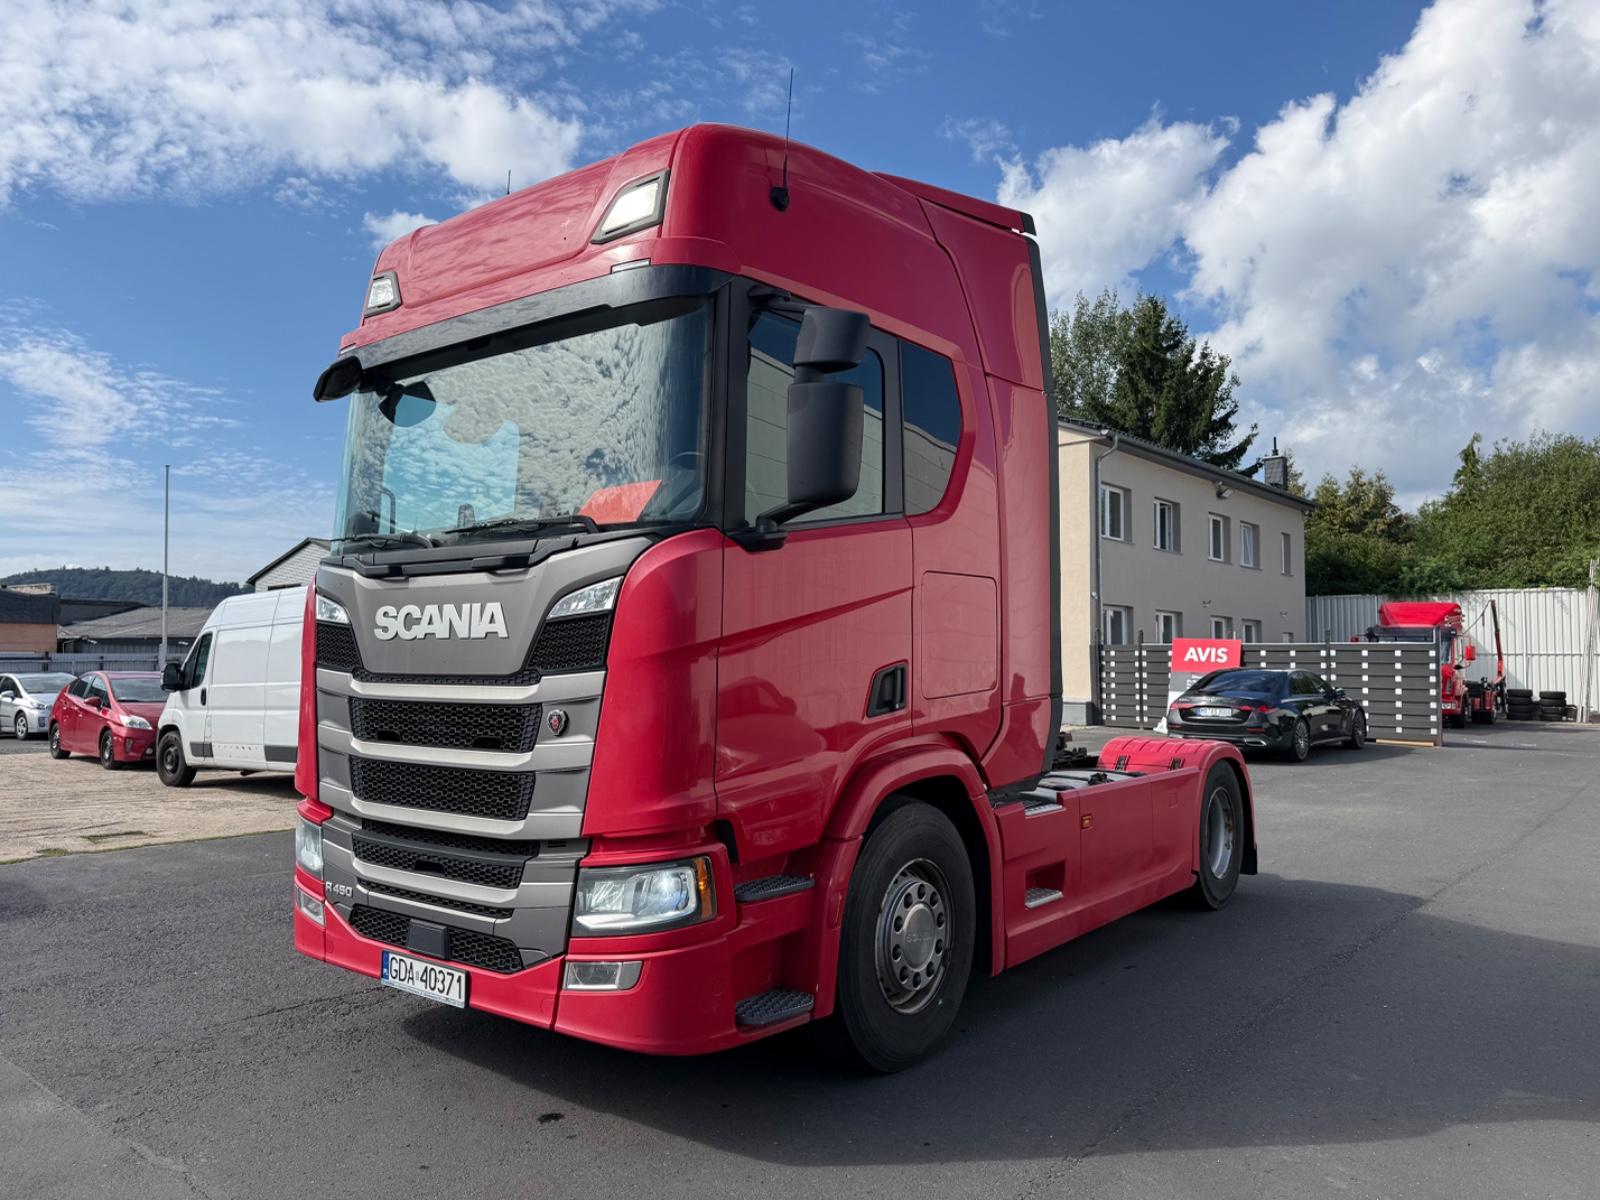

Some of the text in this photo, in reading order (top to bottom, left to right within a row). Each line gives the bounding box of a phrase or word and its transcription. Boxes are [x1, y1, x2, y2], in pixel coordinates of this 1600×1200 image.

[373, 602, 509, 640] SCANIA
[1184, 646, 1228, 663] AVIS
[325, 881, 353, 898] R 450
[390, 956, 415, 986] GDA
[420, 965, 463, 1000] 40371
